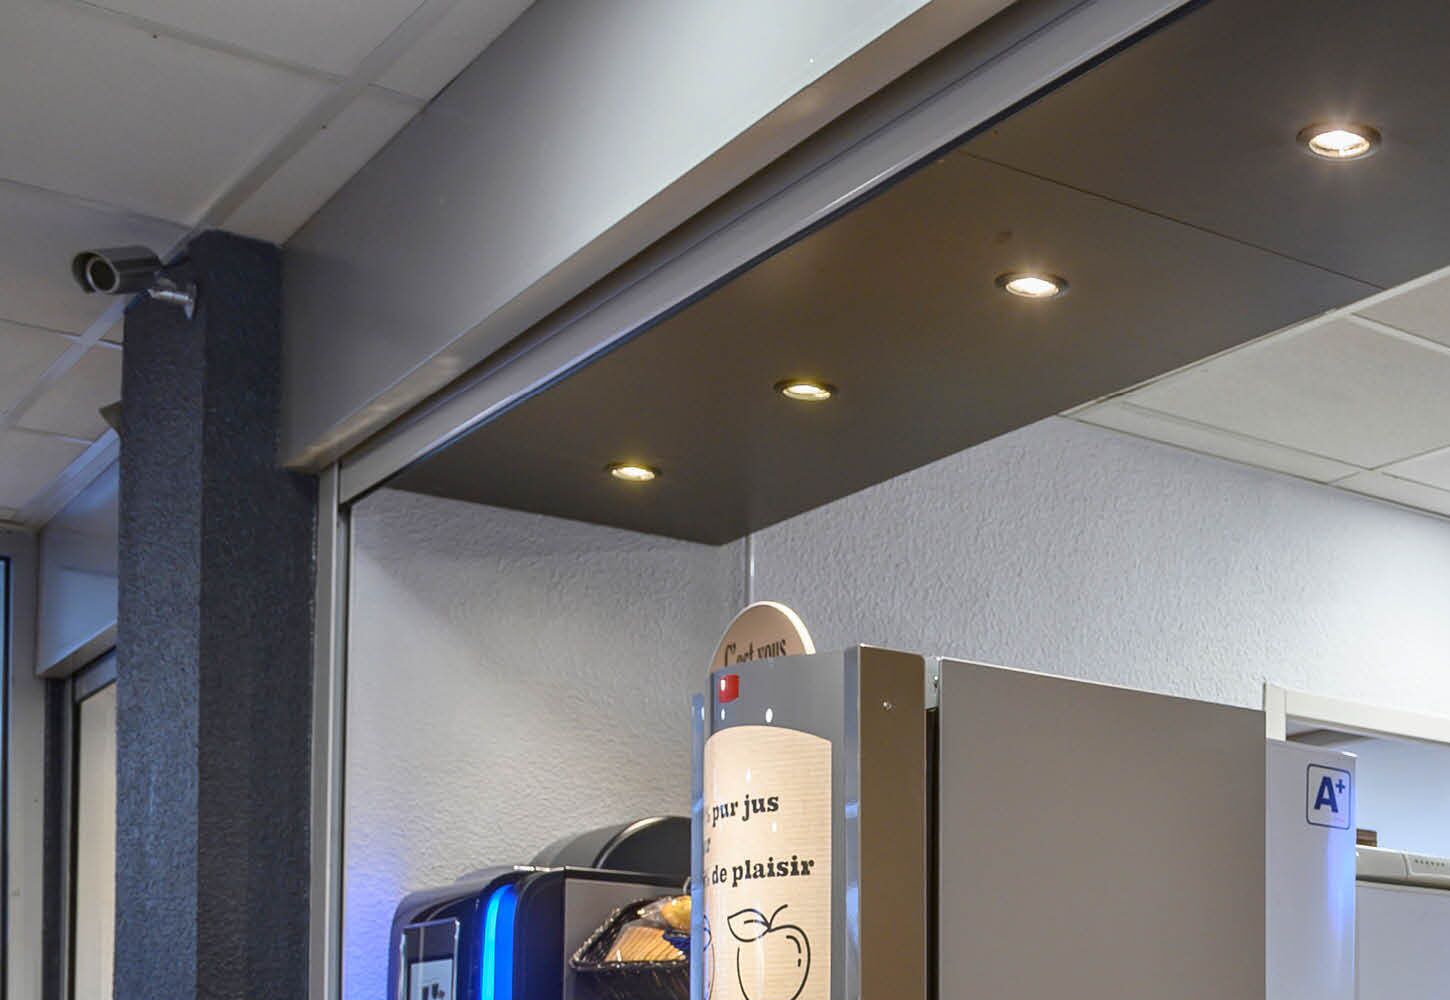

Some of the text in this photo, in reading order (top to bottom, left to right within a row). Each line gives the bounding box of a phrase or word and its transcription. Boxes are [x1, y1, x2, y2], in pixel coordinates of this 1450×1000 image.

[712, 801, 739, 828] pur
[742, 794, 780, 822] jus
[712, 855, 815, 888] de plaisir
